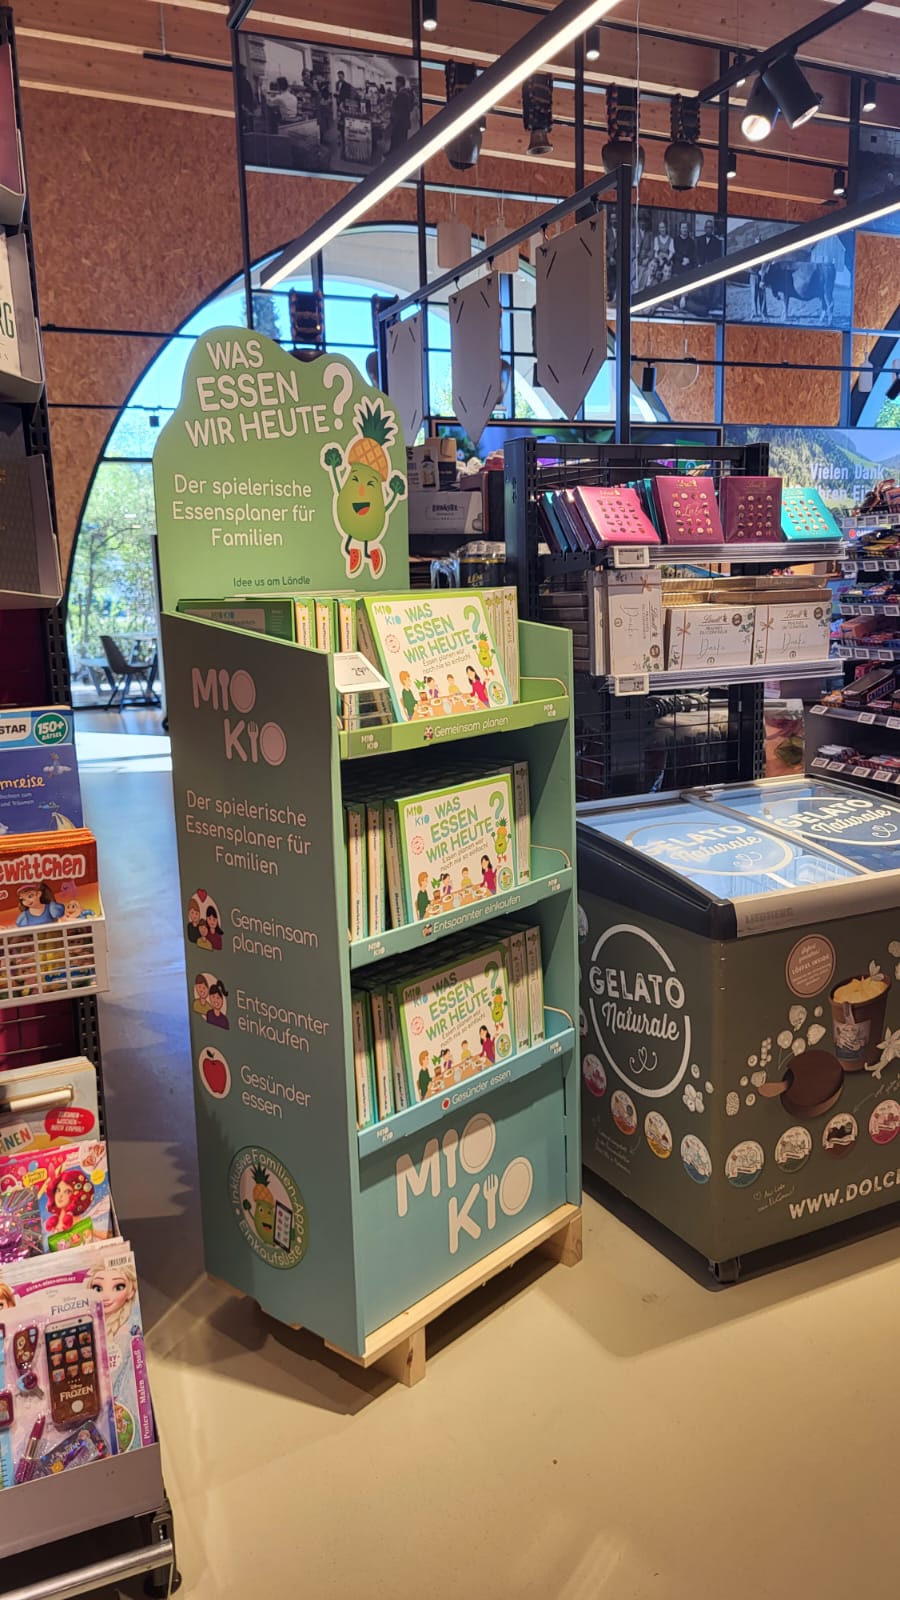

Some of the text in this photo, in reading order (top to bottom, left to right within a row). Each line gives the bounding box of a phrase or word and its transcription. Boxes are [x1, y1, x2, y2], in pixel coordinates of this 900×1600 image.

[206, 340, 263, 370] WAS
[196, 370, 299, 412] ESSEN
[184, 417, 235, 448] WIR
[811, 463, 884, 480] Vielen Dank
[174, 474, 312, 499] Der spielerische
[172, 501, 315, 525] Essensplaner für
[211, 528, 283, 546] Familien
[233, 577, 252, 587] Idee
[254, 578, 264, 586] us
[282, 576, 310, 586] Ländle
[404, 602, 433, 622] WAS
[403, 614, 455, 645] ESSEN
[403, 644, 428, 664] WIR
[192, 667, 256, 714] MIO
[38, 720, 64, 736] 150+
[434, 716, 508, 738] Gemeinsam planen
[224, 718, 286, 766] KIO
[186, 790, 307, 827] Der spielerische
[406, 805, 422, 817] MIO
[415, 814, 430, 826] KIO
[434, 796, 460, 819] WAS
[775, 799, 874, 829] GELATO
[186, 815, 312, 856] Essensplaner für
[430, 804, 478, 843] ESSEN
[811, 809, 892, 836] Naturale
[426, 841, 448, 864] WIR
[640, 824, 747, 857] GELATO
[670, 835, 762, 864] Naturale
[215, 846, 279, 876] Familien
[433, 895, 521, 932] Entspannter einkaufen
[230, 908, 319, 949] Gemeinsam
[232, 933, 282, 962] planen
[429, 977, 474, 1021] ESSEN
[432, 972, 458, 997] WAS
[588, 966, 686, 1009] GELATO
[236, 990, 330, 1036] Entspannter
[602, 1001, 680, 1042] Naturale
[238, 1014, 310, 1052] einkaufen
[426, 1018, 448, 1040] WIR
[240, 1065, 311, 1108] Gesünder
[452, 1070, 512, 1104] Gesünder essen
[242, 1091, 282, 1120] essen
[396, 1112, 496, 1217] MIO
[448, 1156, 534, 1254] KIO
[51, 1298, 89, 1316] FROZEN
[134, 1350, 144, 1369] Spaß
[60, 1385, 94, 1402] FROZEN
[138, 1380, 146, 1404] Malen
